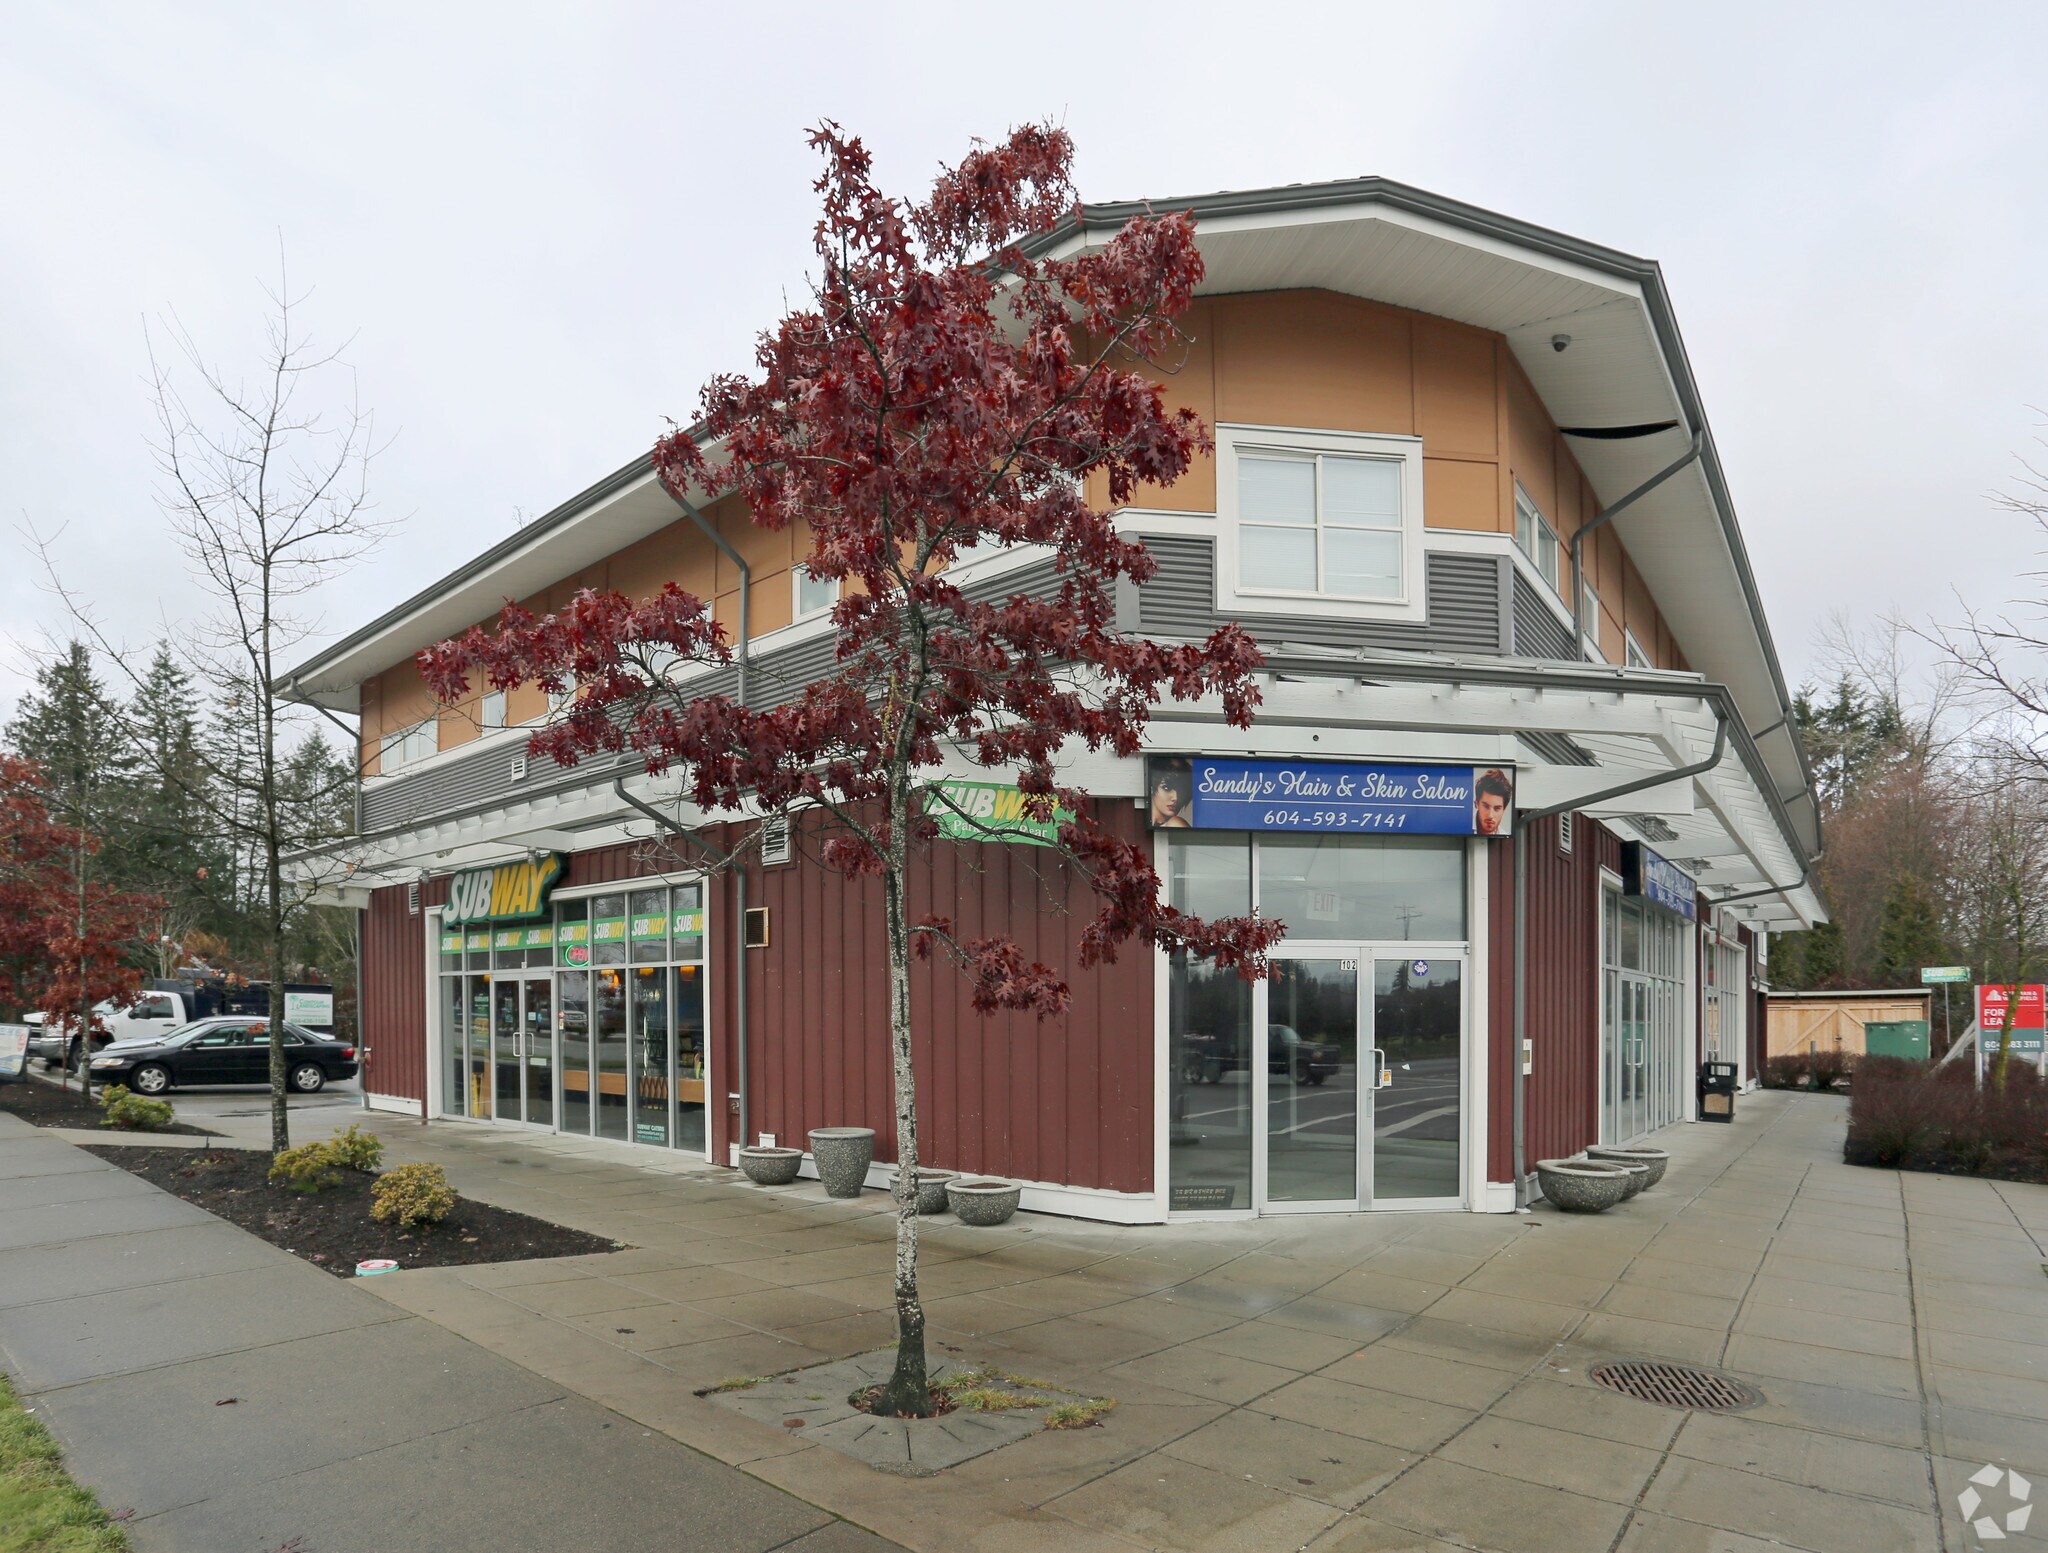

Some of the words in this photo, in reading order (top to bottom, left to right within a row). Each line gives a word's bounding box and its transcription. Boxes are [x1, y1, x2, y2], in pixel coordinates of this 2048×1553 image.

[1199, 767, 1275, 802] Sandy's
[1279, 771, 1332, 797] Hair
[1336, 775, 1355, 797] &
[1361, 772, 1407, 799] Skin
[1412, 774, 1468, 801] Salon
[1264, 810, 1406, 828] 604-593-7141
[442, 853, 557, 924] SUBWAY
[1314, 893, 1333, 912] EXIT
[594, 922, 625, 939] SUBWAY
[631, 917, 667, 936] SUBWAY
[495, 932, 522, 947] SUBWAY
[1342, 960, 1356, 970] 102
[1984, 1008, 2006, 1017] FOR
[1984, 1017, 2016, 1026] LEAE
